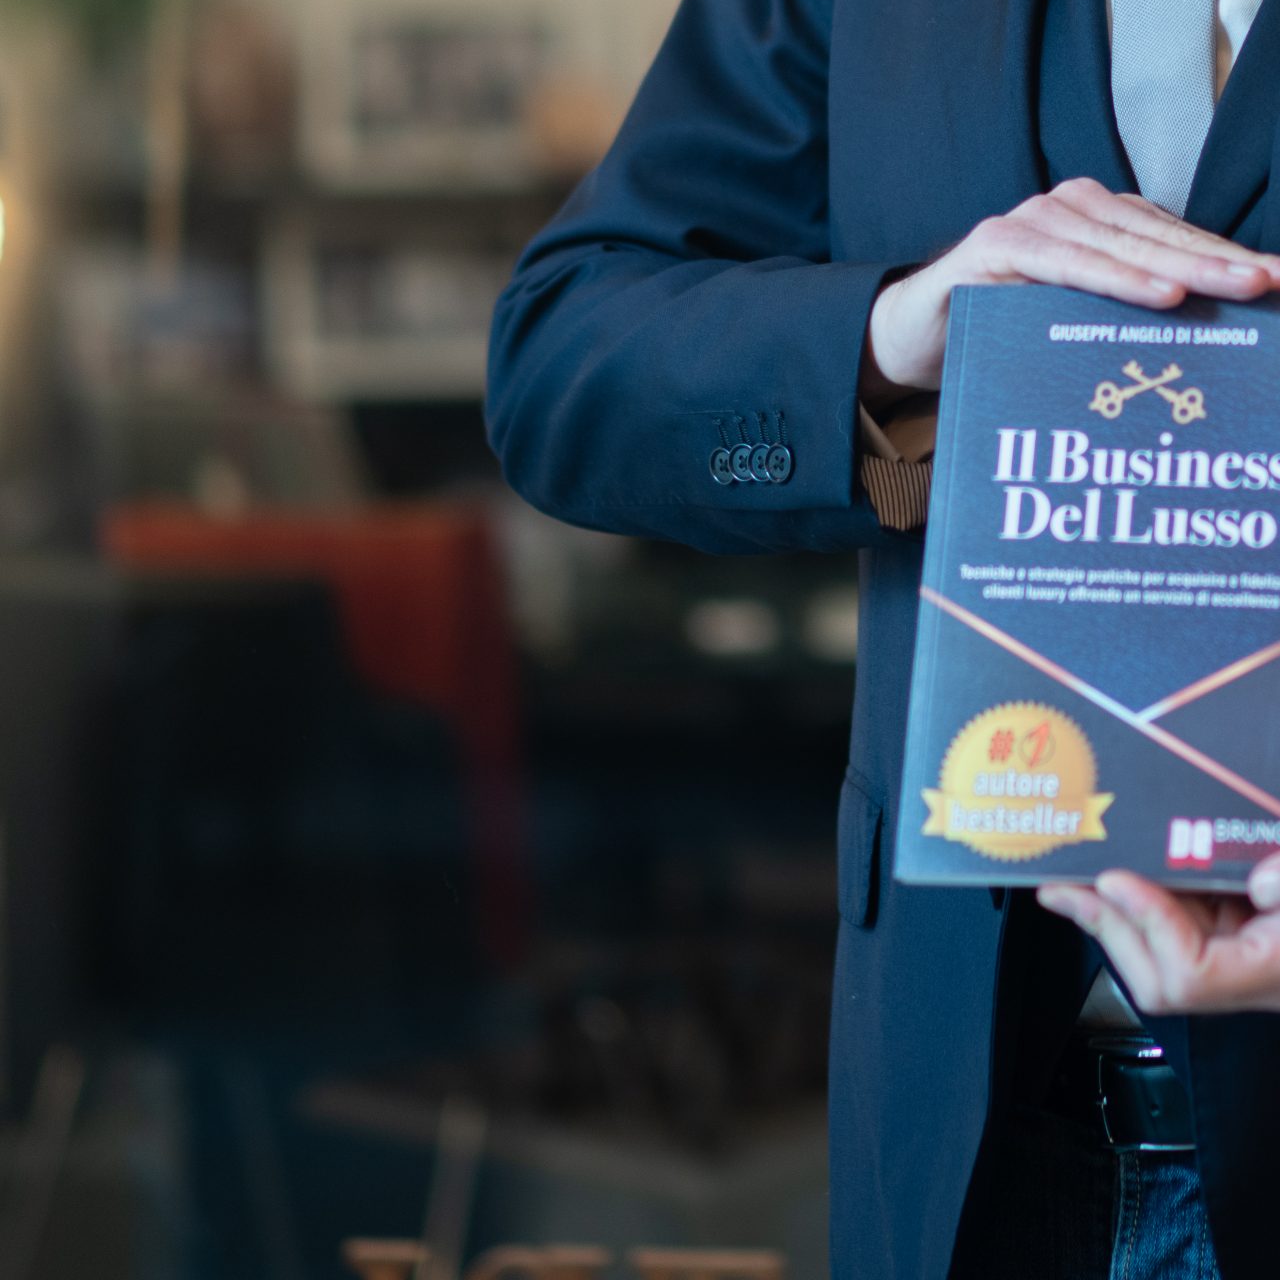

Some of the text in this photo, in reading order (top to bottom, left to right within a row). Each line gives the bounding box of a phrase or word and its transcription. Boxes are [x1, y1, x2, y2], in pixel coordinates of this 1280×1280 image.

[1050, 324, 1117, 342] GIUSEPPE
[1119, 326, 1174, 343] ANGELO
[1175, 327, 1191, 344] DI
[992, 428, 1036, 482] Il
[999, 486, 1277, 548] Del Lusso
[960, 564, 1015, 580] Tecniche
[1016, 567, 1026, 581] e
[1028, 566, 1085, 585] strategie
[1087, 567, 1141, 585] pratiche
[1142, 571, 1165, 587] per
[1167, 570, 1227, 589] acquisire
[1229, 574, 1238, 588] e
[982, 583, 1024, 599] clienti
[1026, 583, 1066, 604] luxury
[1068, 585, 1122, 602] offrendo
[1123, 590, 1141, 604] un
[1142, 589, 1194, 606] servizio
[1195, 590, 1210, 606] di
[974, 767, 1059, 798] autore
[950, 801, 1082, 835] bestseller
